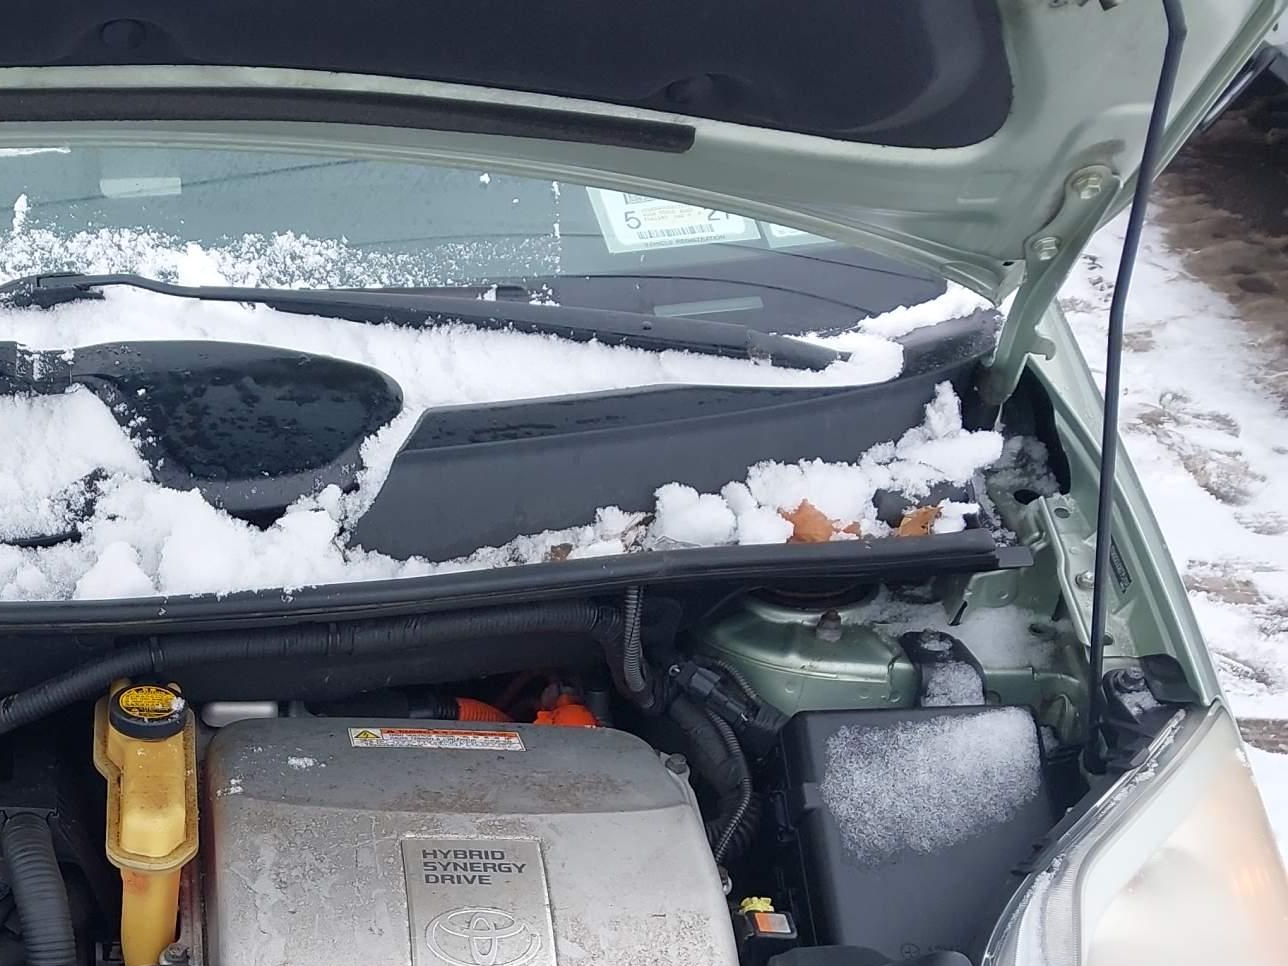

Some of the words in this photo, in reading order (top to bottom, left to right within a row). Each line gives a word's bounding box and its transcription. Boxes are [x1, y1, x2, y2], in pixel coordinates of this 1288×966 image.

[624, 210, 642, 230] 5
[423, 849, 505, 860] HYBRID
[423, 861, 527, 874] SYNERGY
[424, 874, 492, 886] DRIVE
